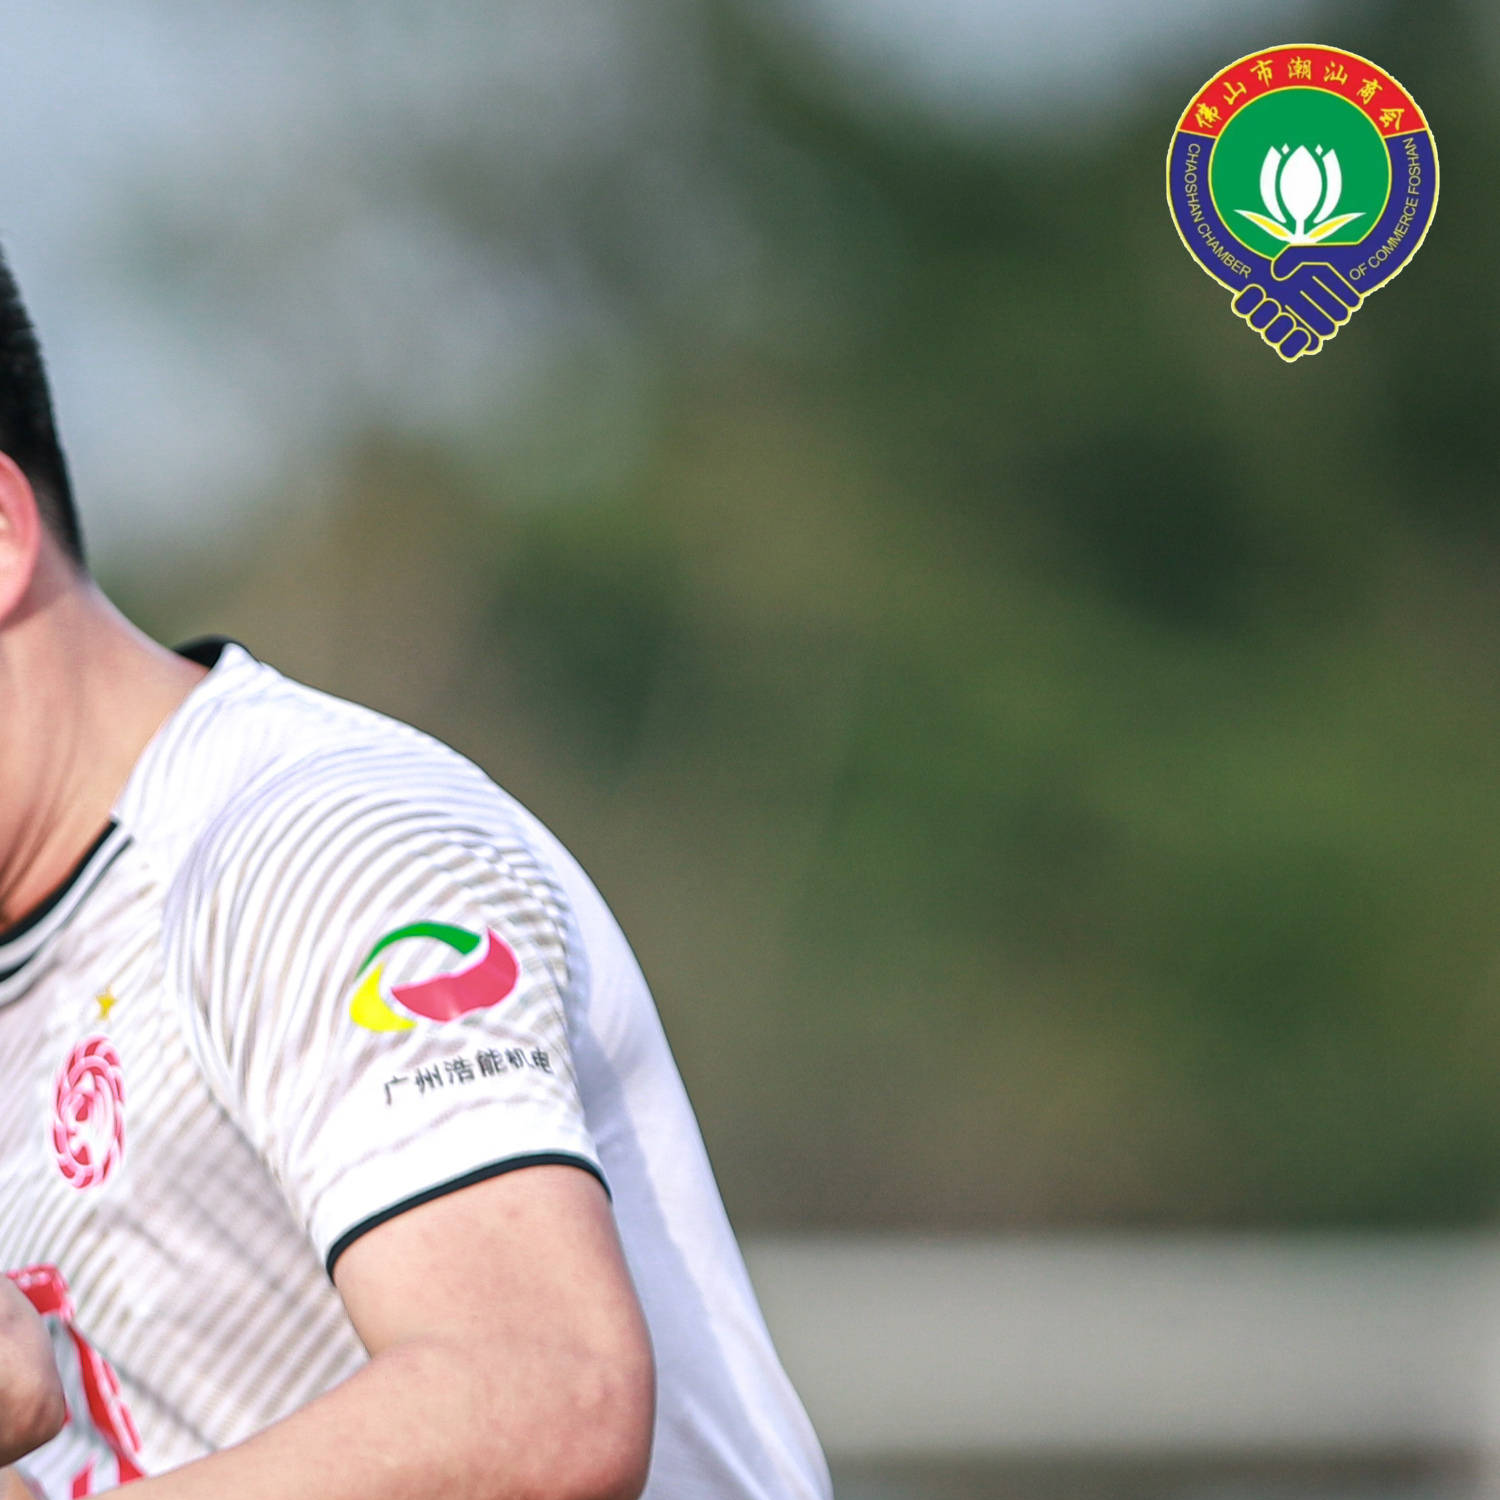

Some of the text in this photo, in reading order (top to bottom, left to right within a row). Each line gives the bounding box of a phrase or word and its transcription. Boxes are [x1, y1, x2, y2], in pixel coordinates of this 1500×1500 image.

[384, 1046, 554, 1106] 广州浩能机电
